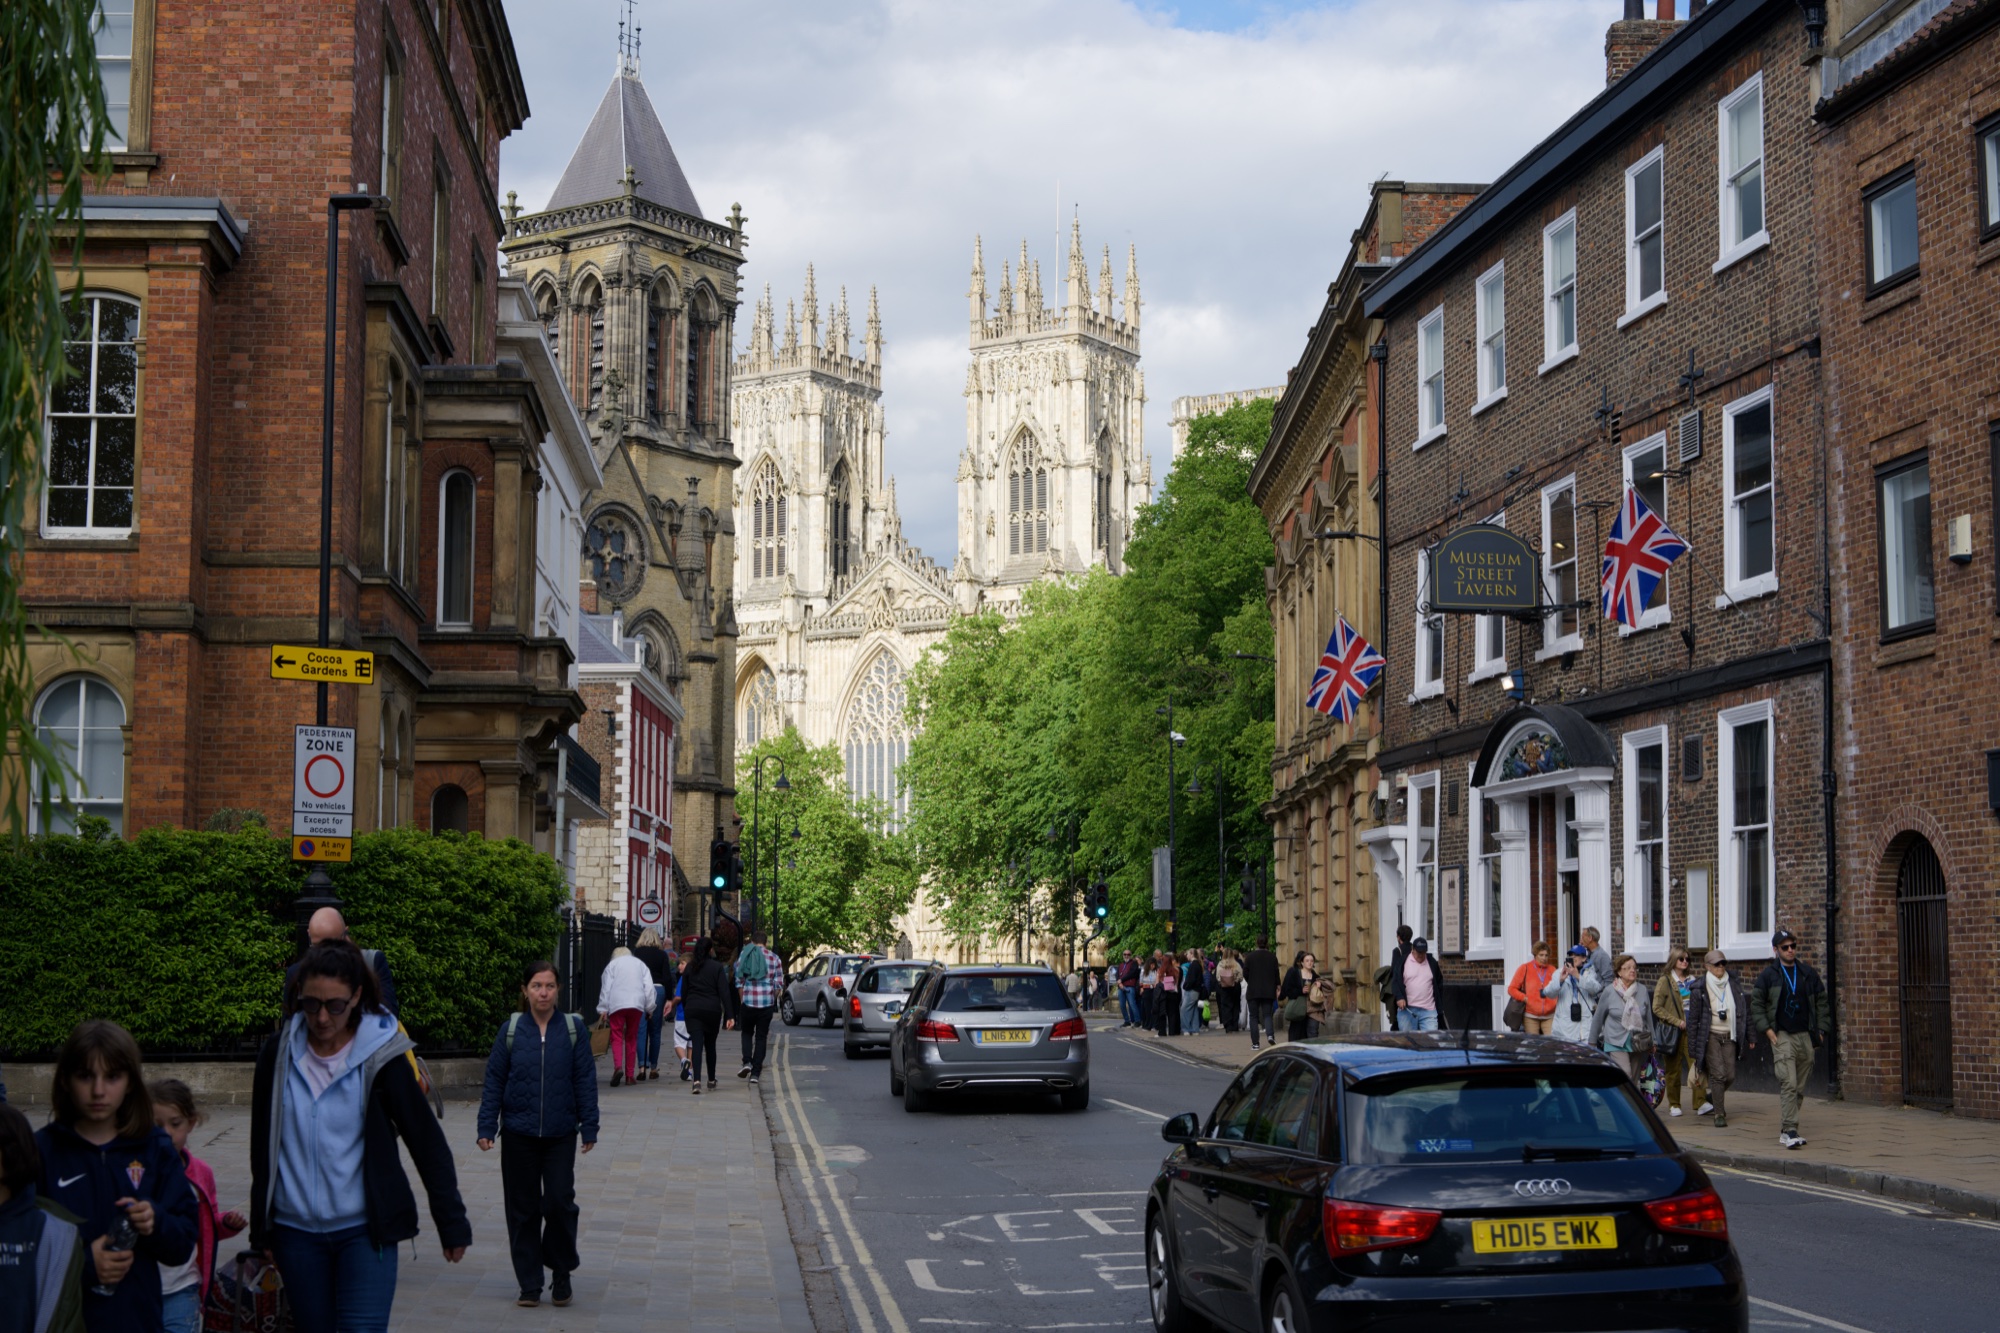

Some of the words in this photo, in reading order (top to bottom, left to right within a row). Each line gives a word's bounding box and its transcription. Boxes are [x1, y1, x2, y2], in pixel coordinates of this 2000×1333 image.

[1450, 550, 1522, 566] MUSEUM
[1457, 565, 1515, 581] STREET
[1454, 581, 1517, 596] TAVERN
[307, 652, 342, 664] Cocoa
[301, 664, 348, 676] Gardens
[299, 728, 352, 739] PEDESTRIAN
[306, 739, 344, 752] ZONE
[301, 801, 313, 809] No
[315, 801, 346, 811] vehicles
[303, 816, 330, 825] Except
[332, 816, 343, 825] for
[332, 842, 346, 850] any
[324, 849, 341, 857] time
[984, 1030, 1007, 1041] LN16
[1009, 1030, 1027, 1041] XKX
[1490, 1222, 1547, 1248] HD15
[1553, 1220, 1602, 1246] EWK
